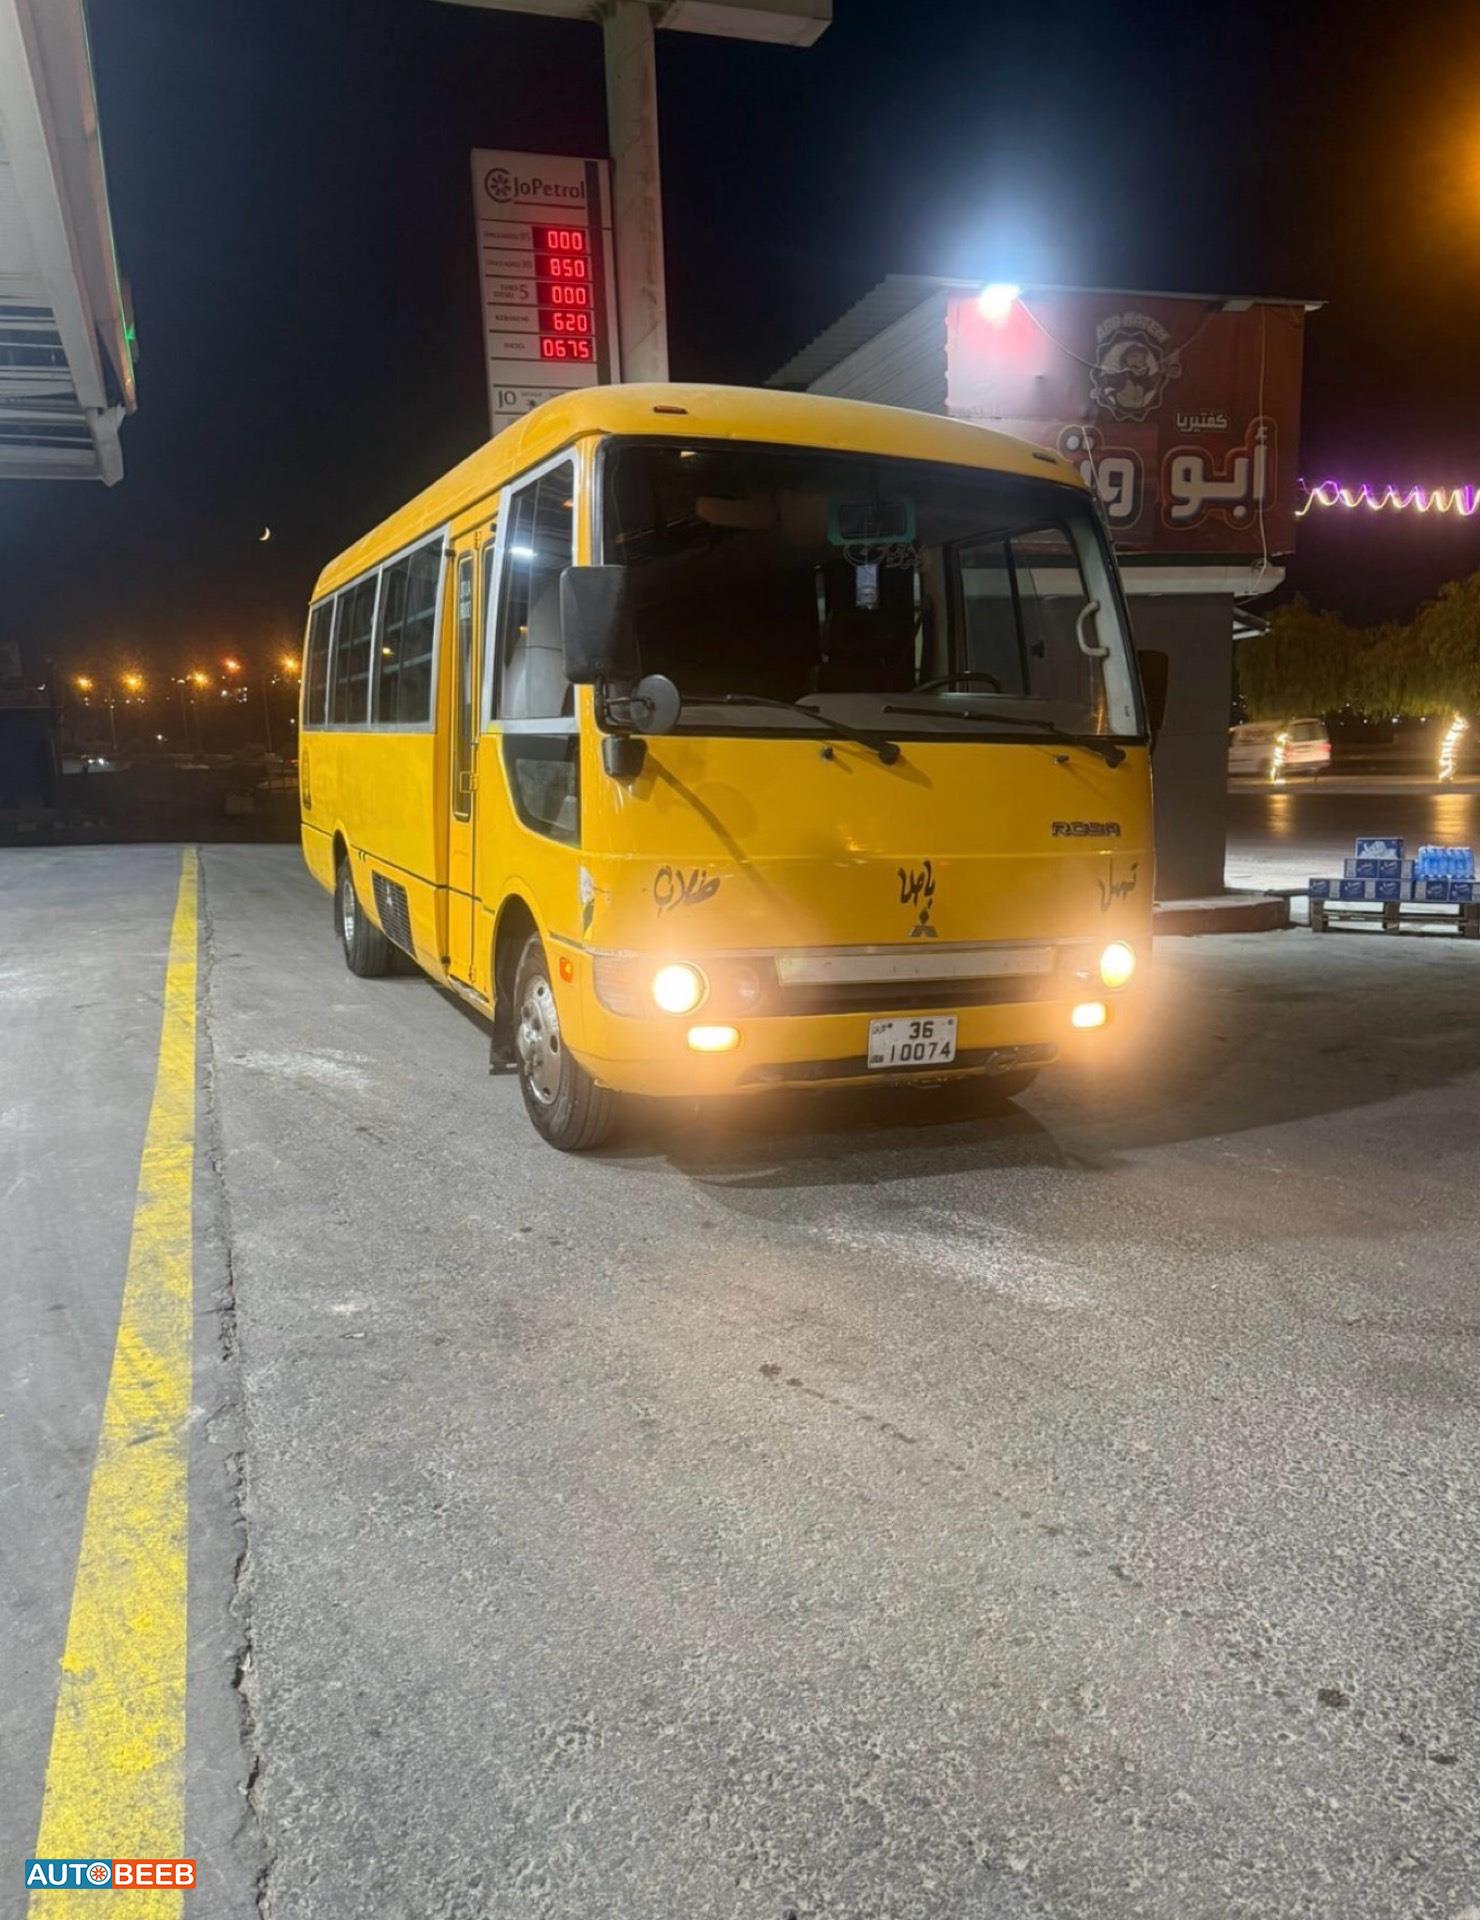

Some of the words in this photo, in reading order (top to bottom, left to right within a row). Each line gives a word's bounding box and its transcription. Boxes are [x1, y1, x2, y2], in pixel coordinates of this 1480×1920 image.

[513, 176, 585, 199] JoPetrol
[547, 230, 583, 250] 000
[550, 258, 585, 277] 850
[519, 283, 530, 300] 5
[552, 286, 586, 305] 000
[553, 312, 587, 332] 620
[543, 339, 589, 358] 0675
[1170, 425, 1268, 519] أبو
[908, 1020, 935, 1040] 36
[889, 1041, 952, 1063] 10074
